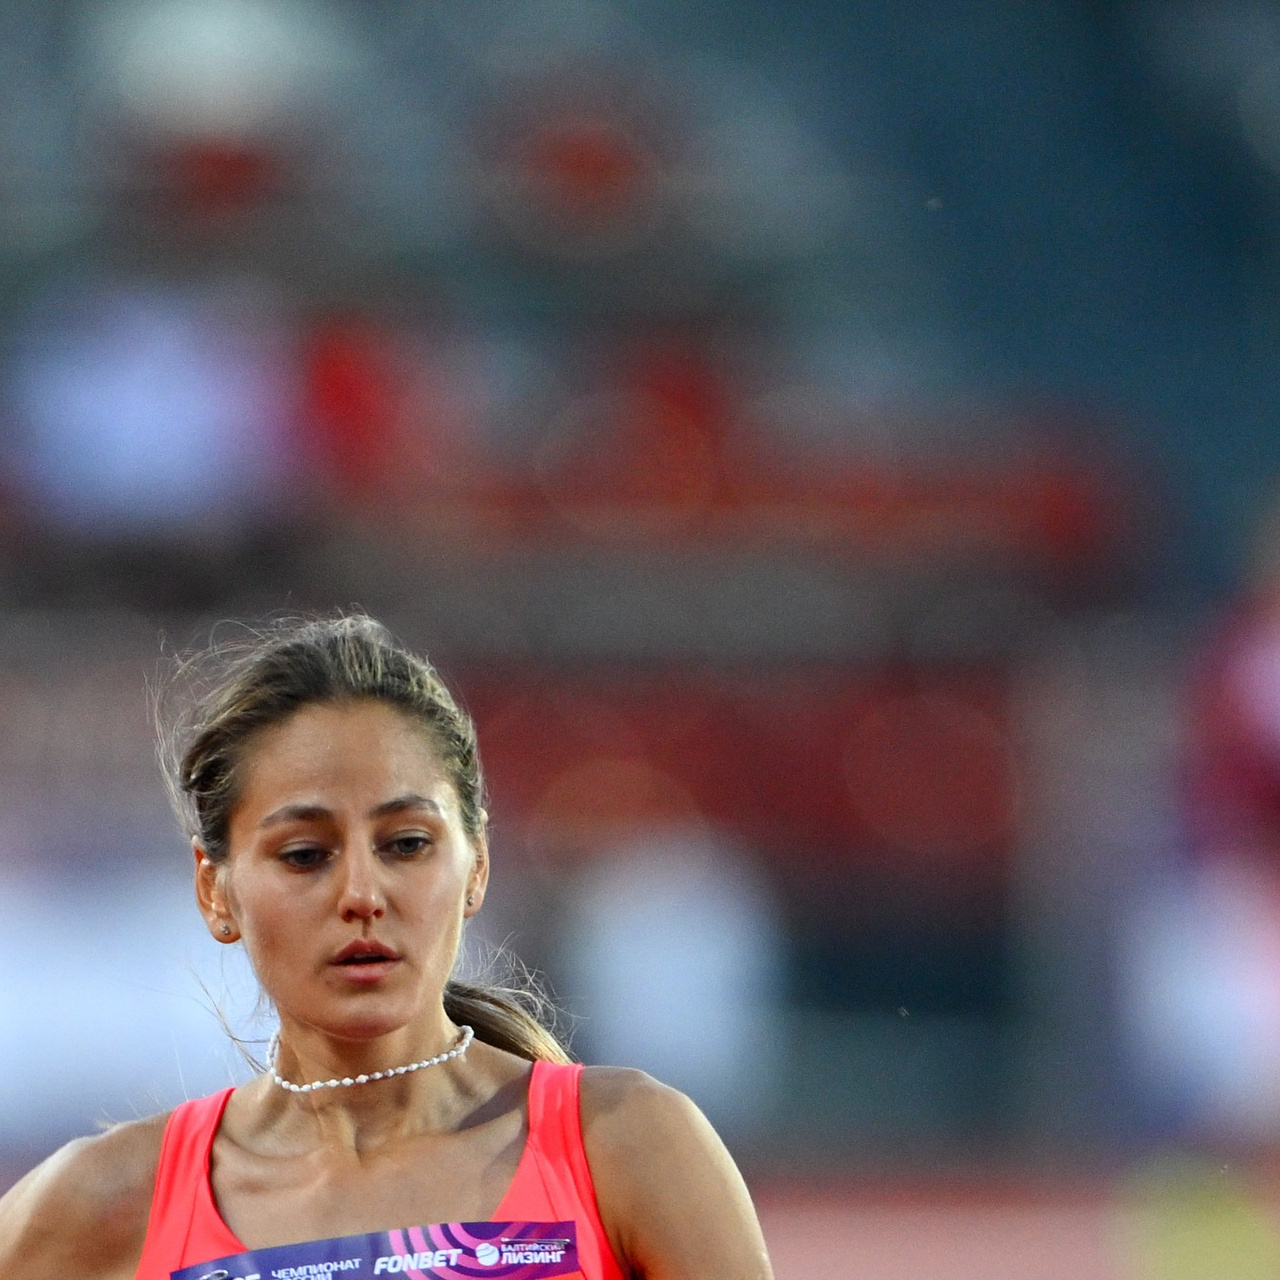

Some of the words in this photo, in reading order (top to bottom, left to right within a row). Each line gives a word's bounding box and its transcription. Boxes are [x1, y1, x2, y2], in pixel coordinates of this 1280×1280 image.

[272, 1258, 362, 1279] ЧЕМПИОНАТ
[373, 1249, 463, 1275] FONBET
[501, 1251, 566, 1265] ЛИЗИНГ
